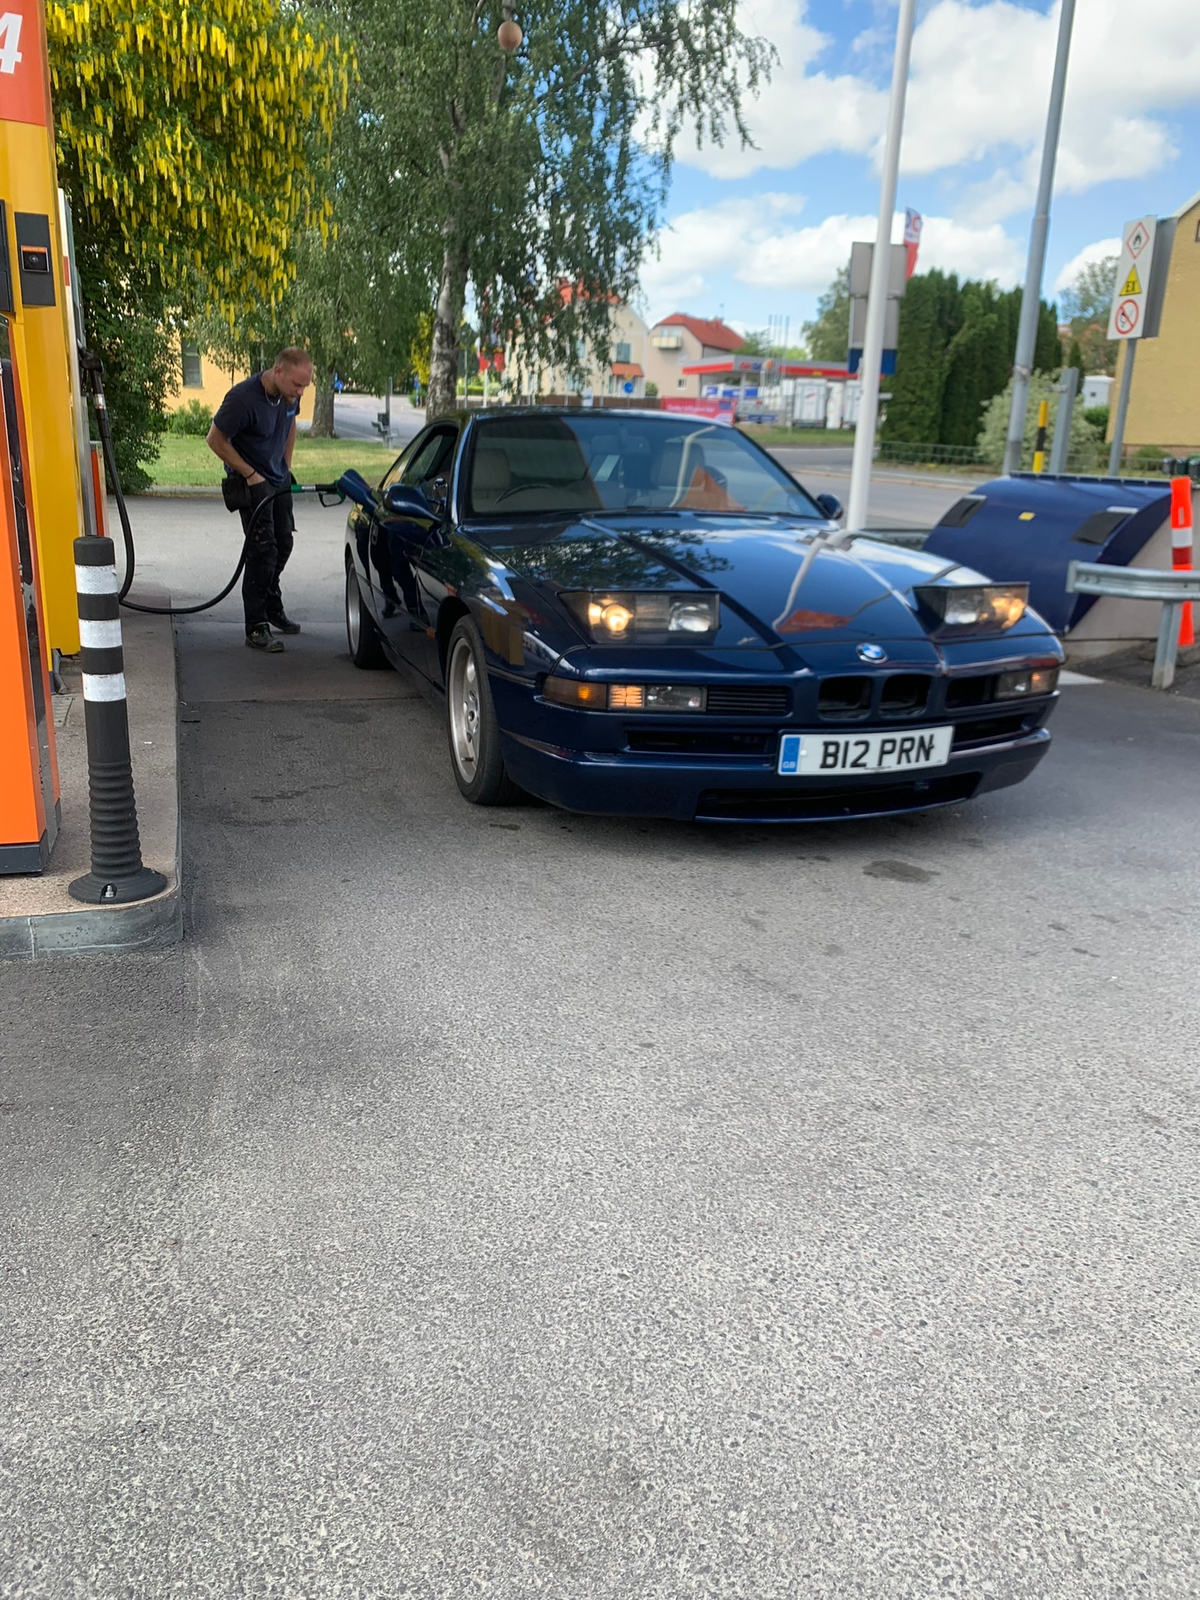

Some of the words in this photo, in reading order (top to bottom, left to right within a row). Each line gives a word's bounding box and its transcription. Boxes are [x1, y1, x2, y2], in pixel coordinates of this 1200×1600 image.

[0, 12, 23, 75] 4
[783, 761, 796, 769] GB
[819, 740, 870, 769] B12
[877, 734, 935, 767] PRN
